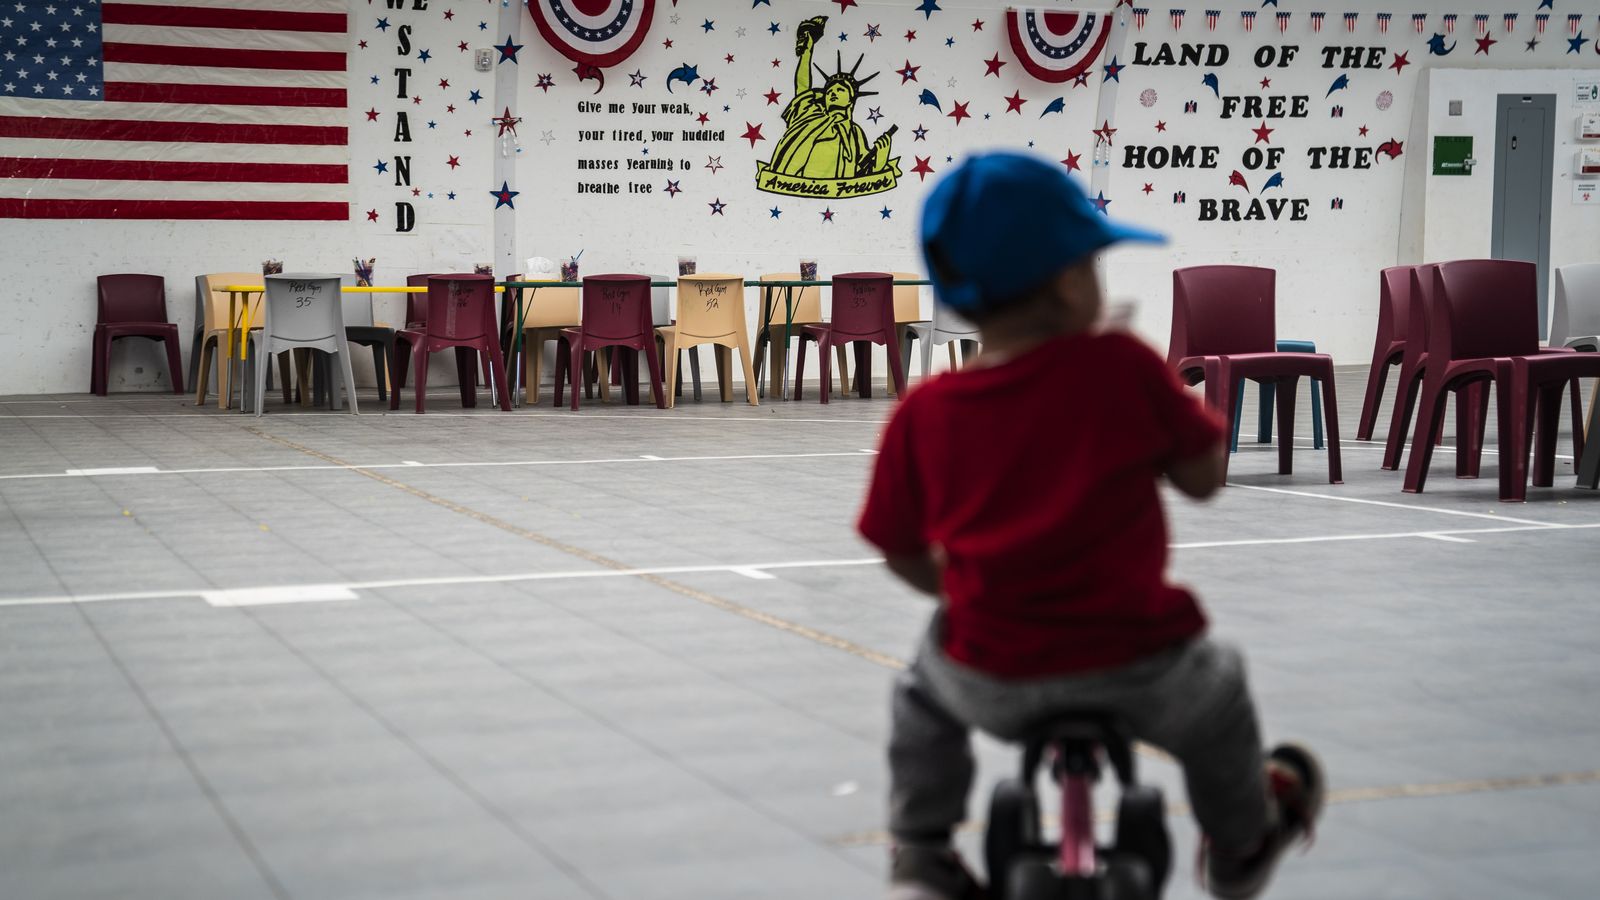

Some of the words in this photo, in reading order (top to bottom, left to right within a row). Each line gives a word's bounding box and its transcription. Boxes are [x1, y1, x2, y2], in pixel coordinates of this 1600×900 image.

[1132, 42, 1230, 67] LAND
[1254, 45, 1299, 68] OF
[1321, 46, 1386, 69] THE
[577, 100, 602, 113] Give
[608, 103, 625, 113] me
[660, 103, 693, 115] weak,
[1220, 95, 1309, 119] FREE
[394, 25, 415, 232] STAND
[578, 130, 605, 142] your
[612, 129, 647, 144] tired,
[651, 130, 674, 142] your
[682, 129, 725, 141] huddled
[577, 159, 619, 170] masses
[626, 158, 674, 171] yearning
[680, 158, 691, 171] to
[1122, 145, 1220, 169] HOME
[1242, 147, 1285, 170] OF
[1307, 147, 1372, 170] THE
[577, 181, 620, 194] breathe
[628, 181, 653, 194] free
[765, 176, 829, 196] America
[836, 176, 893, 197] Forever
[1198, 198, 1309, 222] BRAVE
[296, 296, 315, 309] 35
